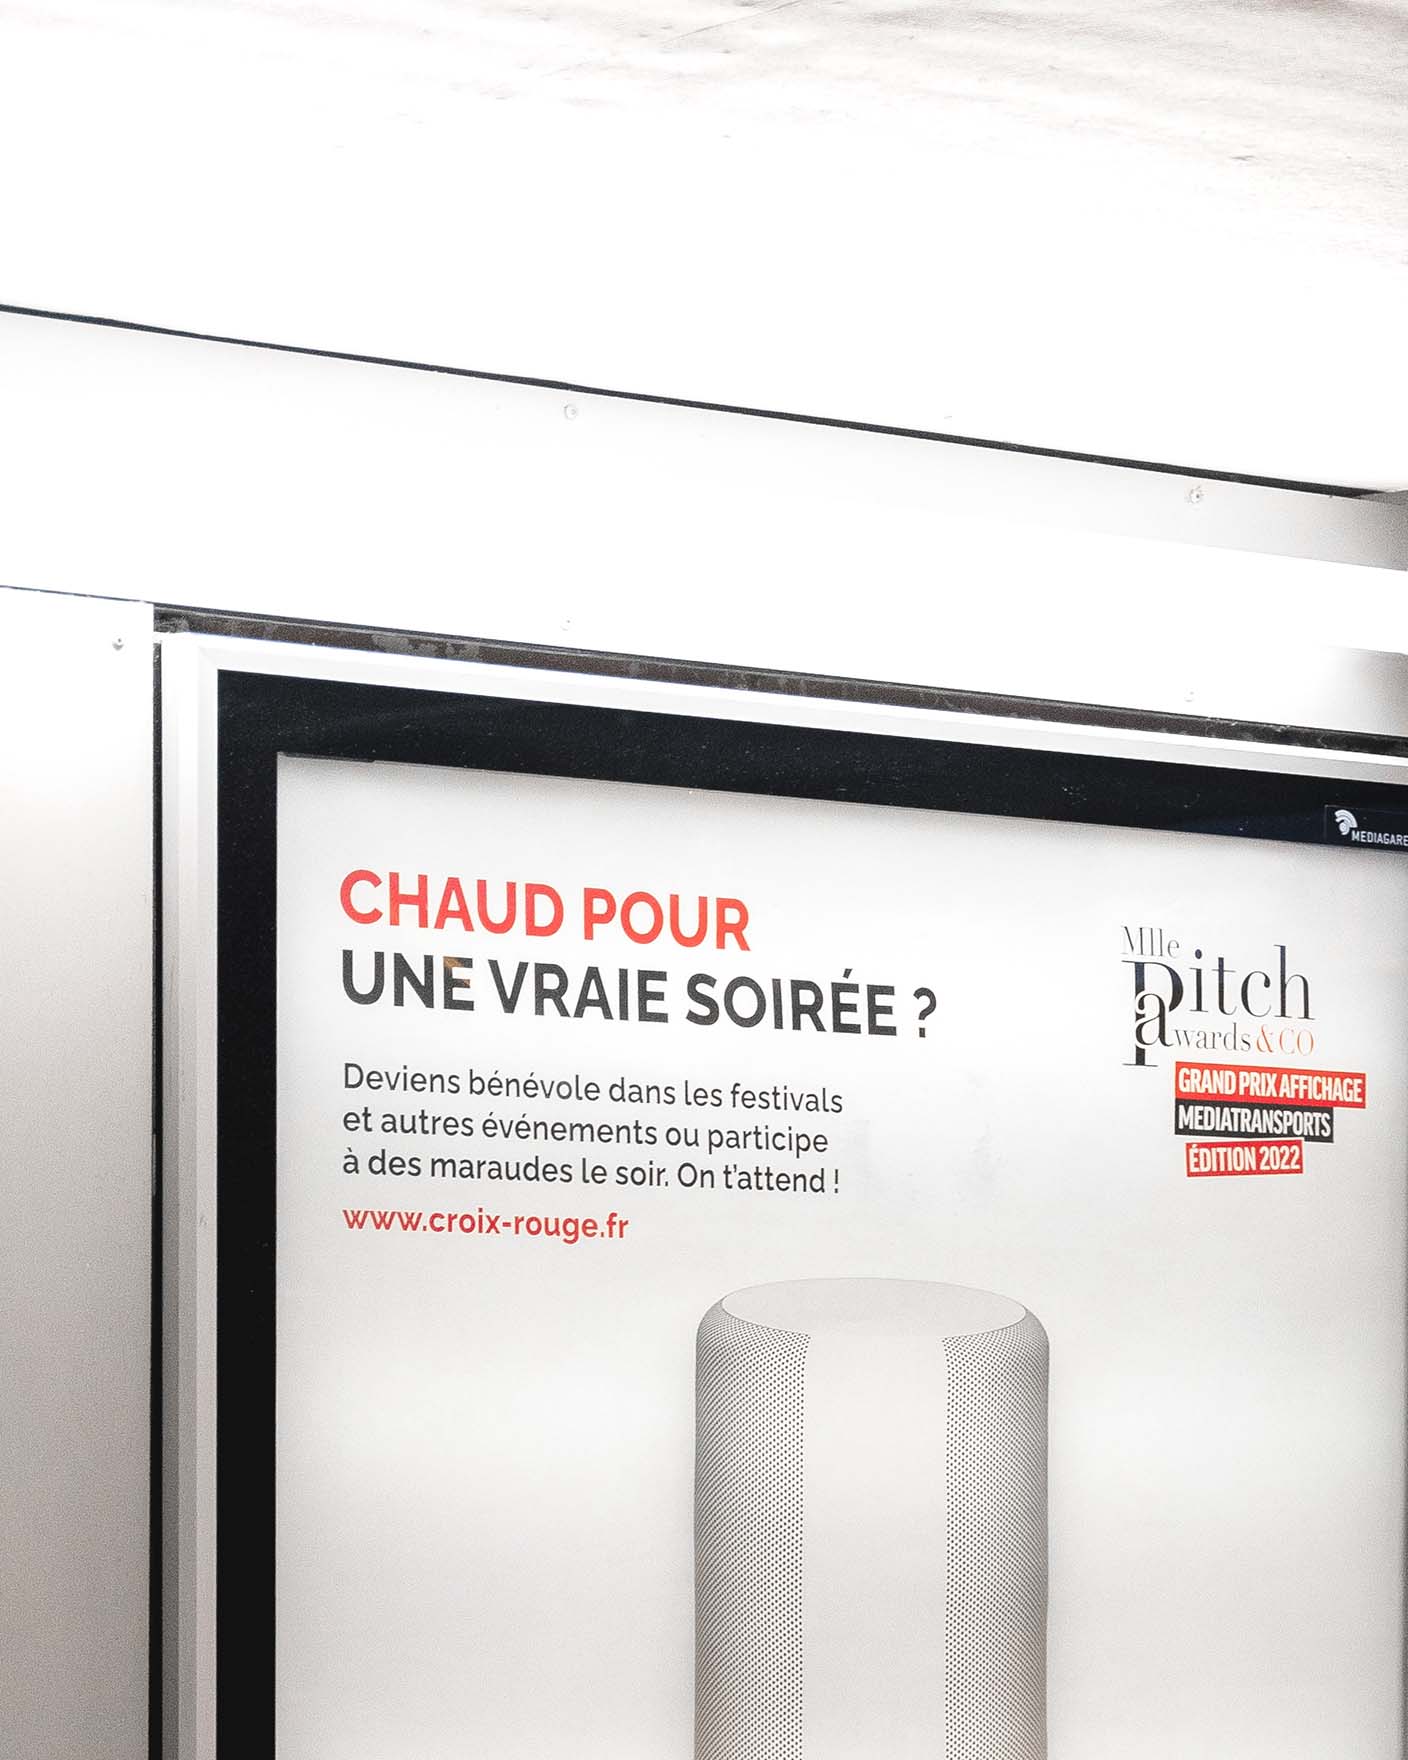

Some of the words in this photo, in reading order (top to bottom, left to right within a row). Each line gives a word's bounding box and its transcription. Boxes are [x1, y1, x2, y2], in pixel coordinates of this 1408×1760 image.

[340, 869, 564, 937] CHAUD
[584, 887, 751, 951] POUR
[1121, 925, 1180, 958] Mlle
[342, 949, 475, 1011] UNE
[488, 959, 669, 1024] VRAIE
[686, 968, 898, 1036] SOIRÉE
[912, 986, 938, 1038] ?
[1121, 944, 1316, 1067] Pitch
[343, 1062, 461, 1095] Deviens
[469, 1068, 601, 1102] bénévole
[608, 1076, 676, 1105] dans
[684, 1079, 723, 1108] les
[730, 1082, 843, 1114] festivals
[1178, 1066, 1236, 1096] GRAND
[1239, 1070, 1280, 1098] PRIX
[1279, 1074, 1363, 1104] AFFICHAGE
[342, 1106, 373, 1133] et
[380, 1108, 475, 1137] autres
[481, 1111, 658, 1146] événements
[665, 1126, 700, 1147] ou
[707, 1124, 829, 1159] participe
[1178, 1104, 1332, 1138] MEDIATRANSPORTS
[342, 1146, 360, 1175] à
[367, 1148, 422, 1177] des
[430, 1154, 573, 1184] maraudes
[581, 1157, 608, 1185] le
[615, 1159, 669, 1187] soir.
[677, 1161, 715, 1189] On
[722, 1163, 825, 1194] t'attend
[833, 1168, 840, 1194] !
[1188, 1142, 1257, 1173] ÉDITION
[1259, 1145, 1301, 1172] 2022
[342, 1206, 630, 1245] www.croix-rouge.fr
